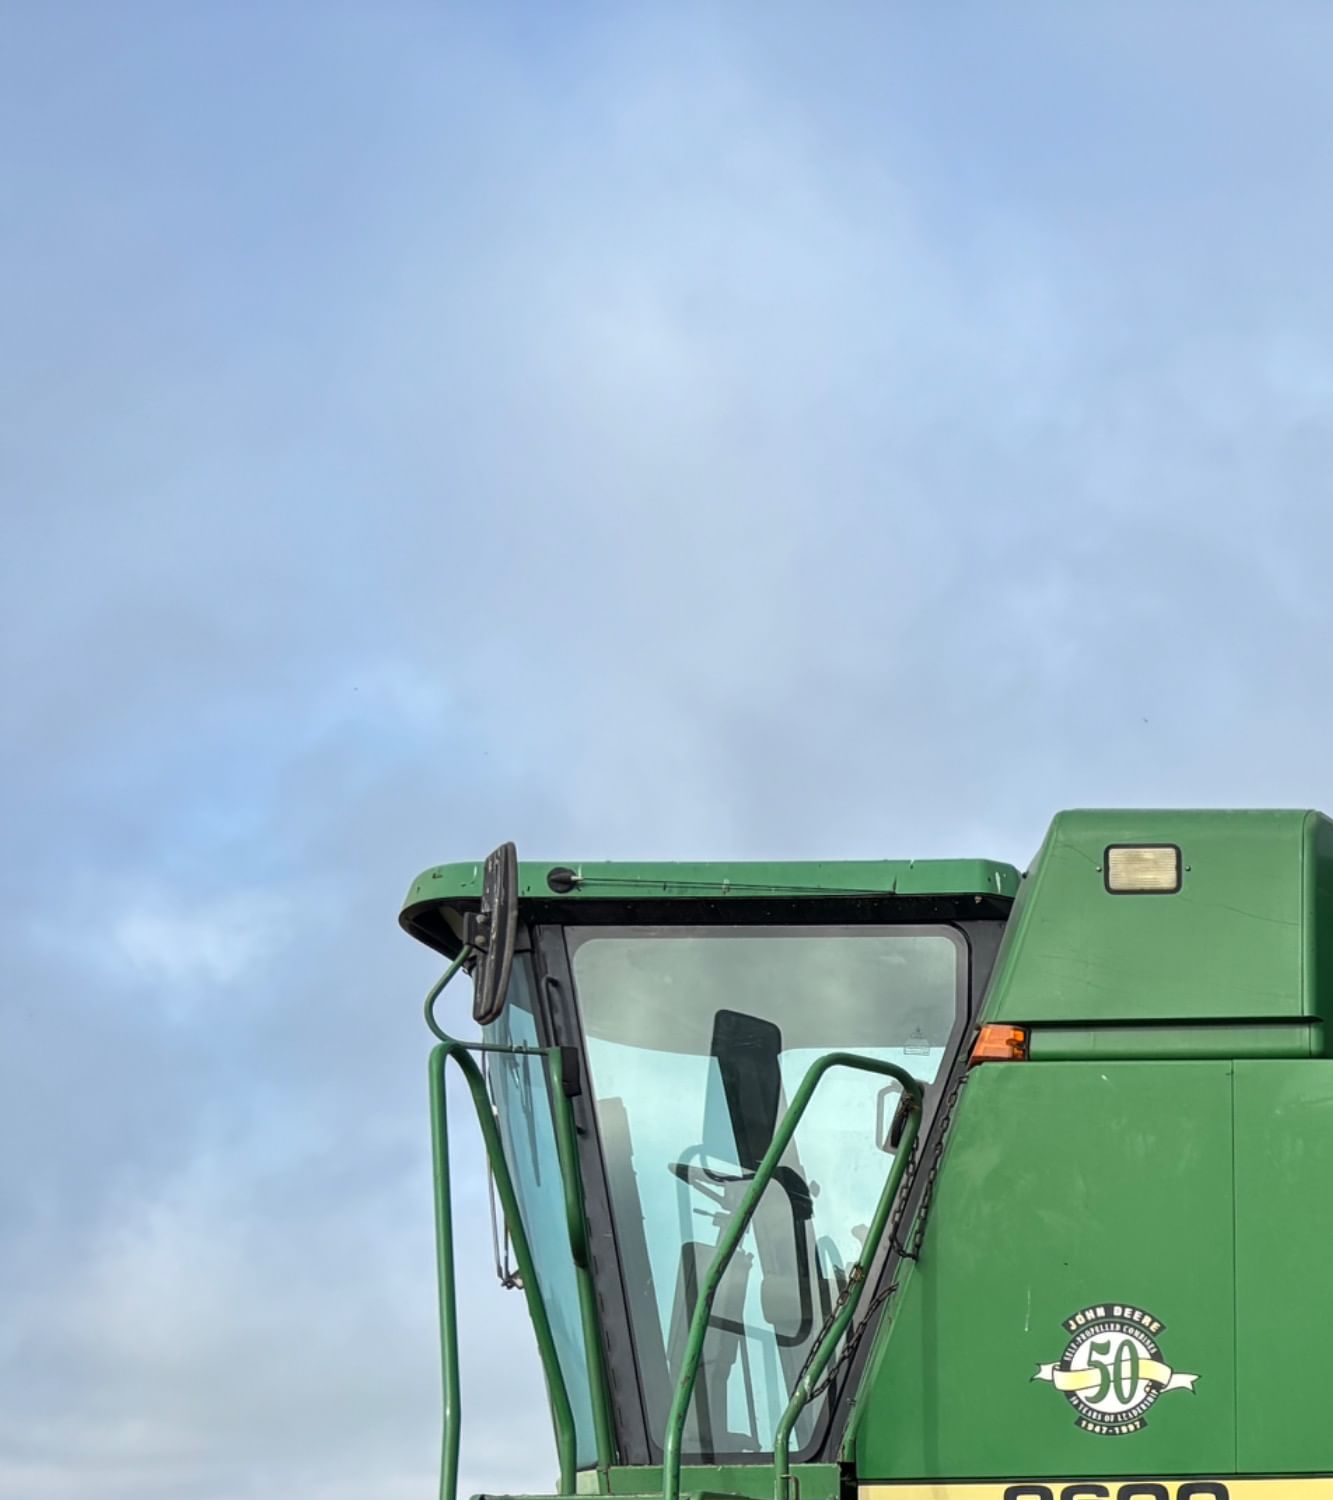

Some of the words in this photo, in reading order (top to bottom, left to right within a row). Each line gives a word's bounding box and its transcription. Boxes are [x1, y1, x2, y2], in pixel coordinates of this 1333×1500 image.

[1068, 1306, 1105, 1330] JOHN
[1113, 1306, 1161, 1333] DEERE
[1084, 1339, 1139, 1405] 50
